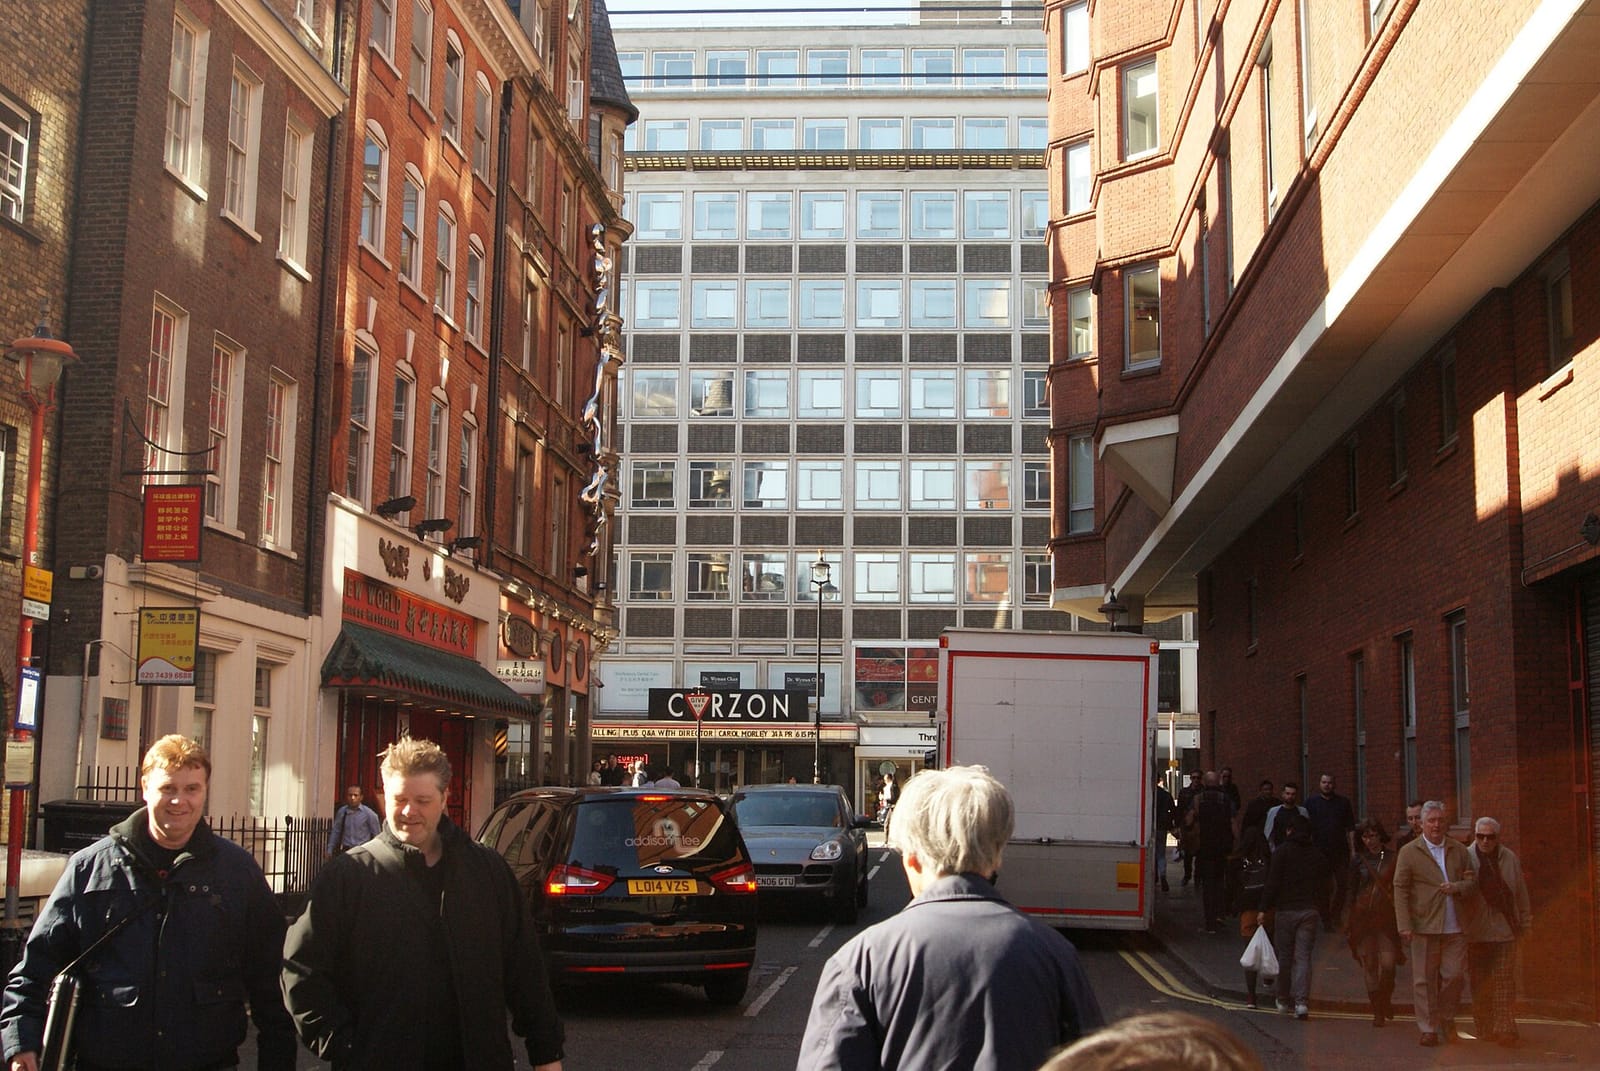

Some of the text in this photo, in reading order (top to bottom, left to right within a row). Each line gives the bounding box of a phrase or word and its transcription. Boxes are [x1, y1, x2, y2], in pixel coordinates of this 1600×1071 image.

[367, 586, 401, 616] WORLD
[668, 693, 788, 718] CRZON
[622, 729, 639, 737] PLUS
[641, 729, 656, 738] Q&A
[658, 729, 676, 737] WITH
[678, 729, 713, 738] DIRECTOR
[718, 730, 740, 738] CAROL
[741, 730, 768, 738] MORLEY
[624, 835, 700, 847] addison lee
[665, 881, 690, 892] VZS
